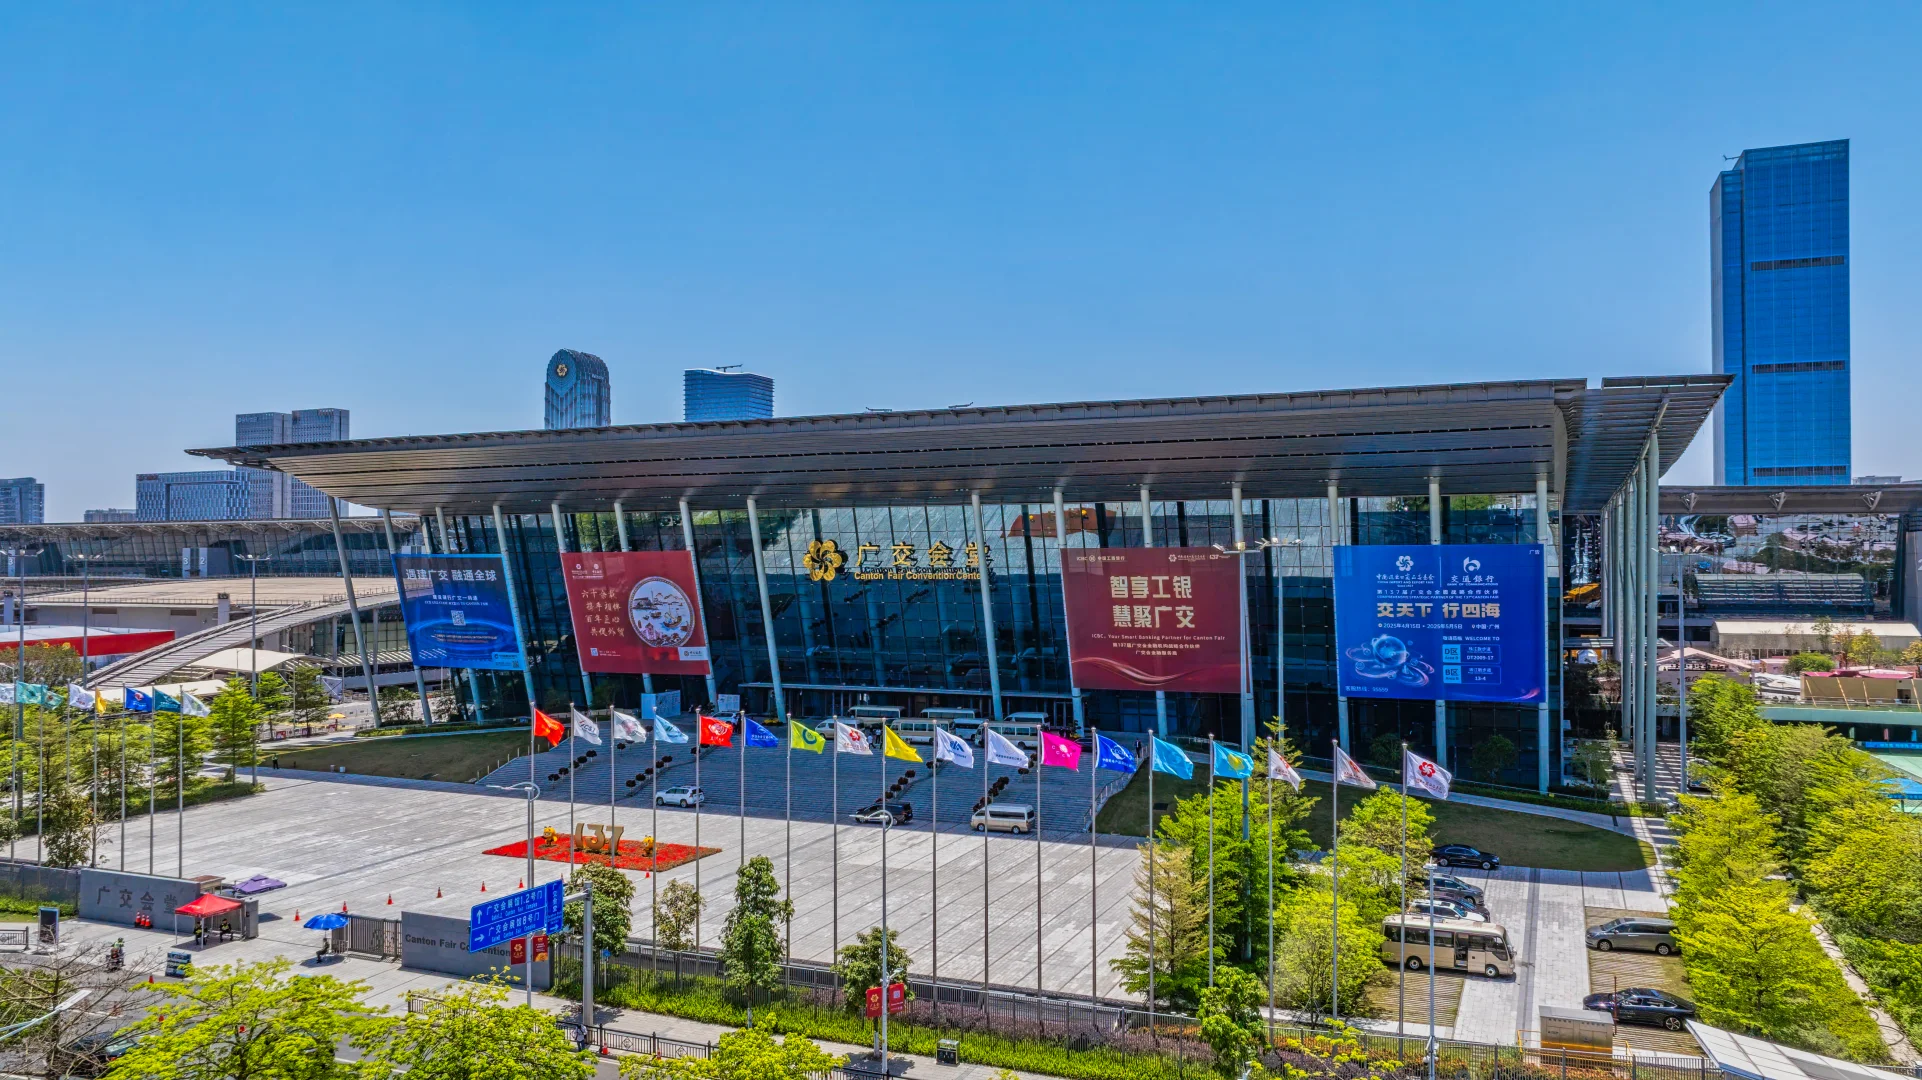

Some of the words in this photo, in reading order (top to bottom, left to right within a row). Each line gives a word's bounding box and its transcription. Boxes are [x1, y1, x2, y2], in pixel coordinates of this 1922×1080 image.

[183, 557, 189, 565] 3
[856, 541, 989, 567] 广交会堂
[406, 569, 449, 581] 遇建广交
[451, 570, 498, 581] 融通全球
[854, 571, 884, 580] Canton
[887, 571, 904, 580] Fair
[906, 571, 955, 580] Convention
[956, 571, 981, 580] Cente
[1110, 575, 1193, 599] 智享工银
[1112, 604, 1196, 629] 慧聚广交
[1377, 602, 1434, 618] 交天下
[1442, 602, 1500, 618] 行四海
[1445, 668, 1458, 676] B区
[575, 822, 624, 853] 137
[97, 886, 178, 914] 广交会堂
[405, 934, 436, 946] Canton
[440, 939, 457, 949] Fair
[460, 941, 511, 957] Coention
